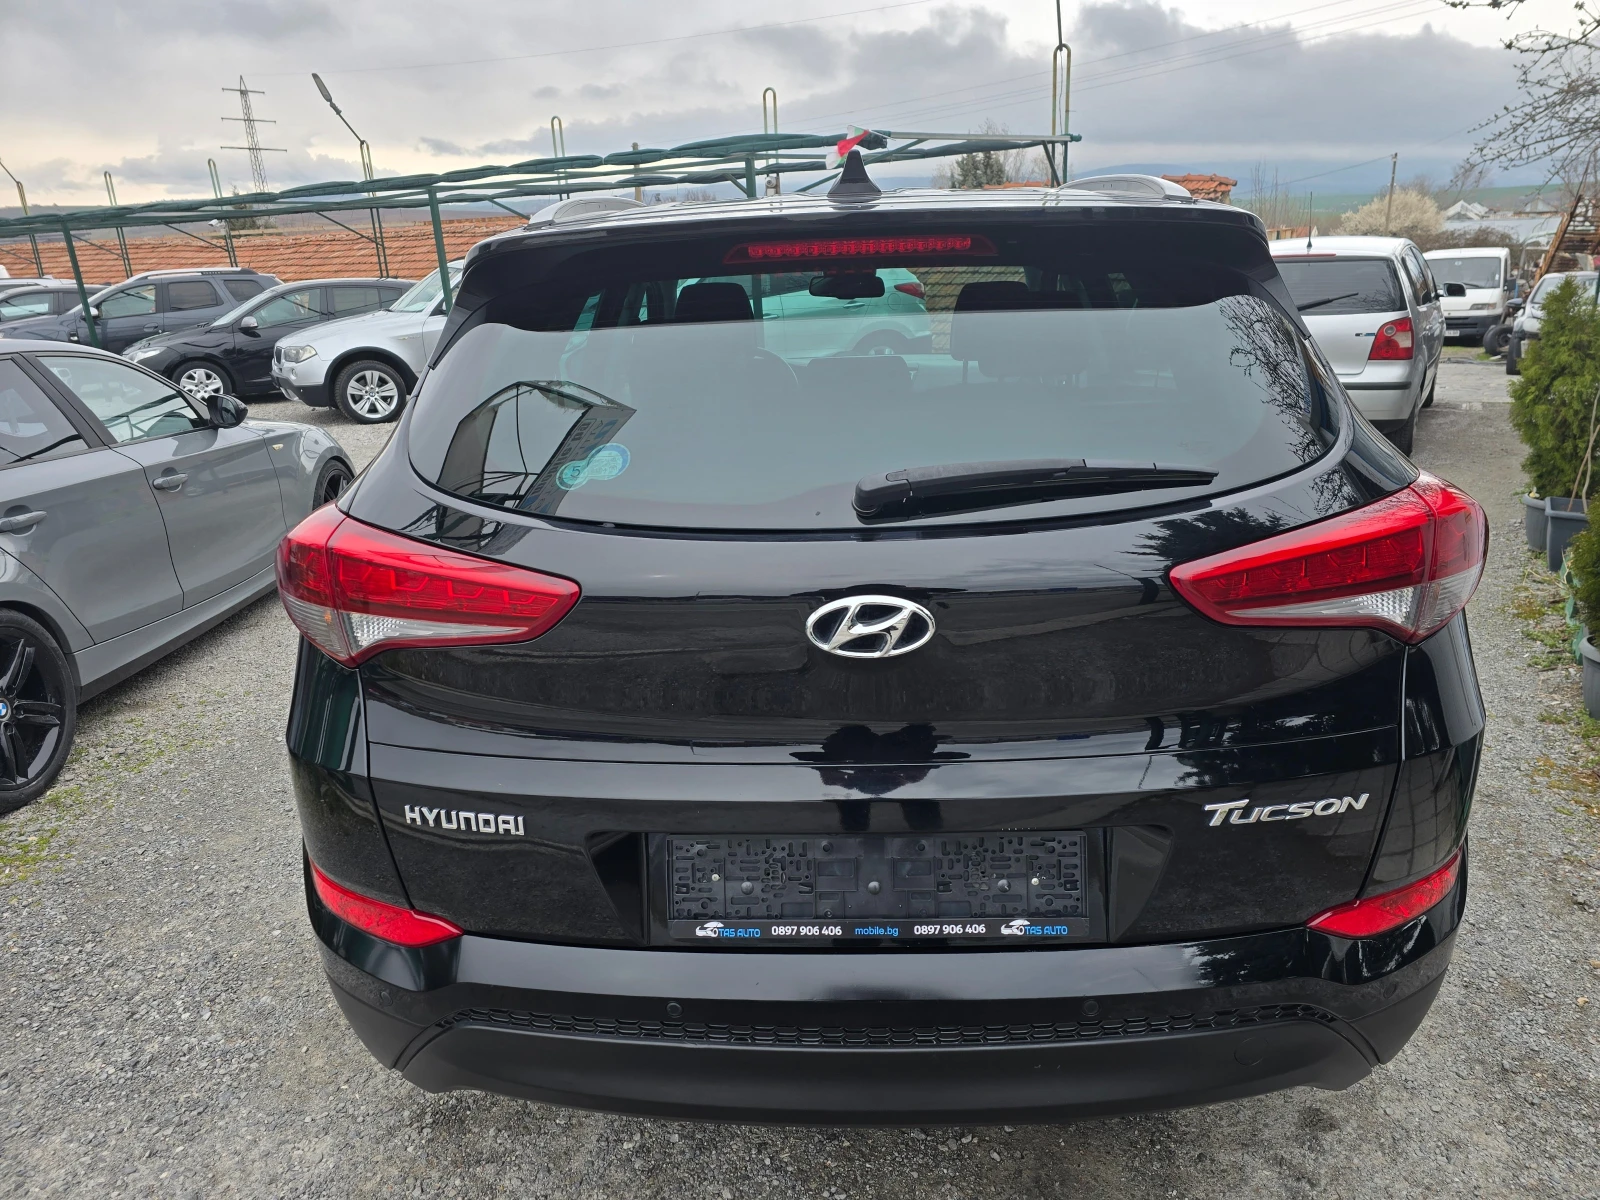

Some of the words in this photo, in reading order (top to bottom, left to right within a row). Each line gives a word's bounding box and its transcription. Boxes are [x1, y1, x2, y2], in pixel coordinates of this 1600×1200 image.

[404, 804, 525, 836] HYUNDAI
[1204, 793, 1370, 826] TUCSON
[718, 928, 735, 937] TAS
[737, 928, 761, 938] AUTO
[771, 926, 797, 936] 0897
[800, 926, 820, 936] 906
[821, 925, 843, 936] 406
[855, 926, 898, 937] mobile.bg
[914, 925, 939, 935] 0897
[942, 924, 963, 934] 906
[965, 924, 986, 934] 406
[1025, 926, 1042, 935] TAS
[1043, 926, 1068, 935] AUTO
